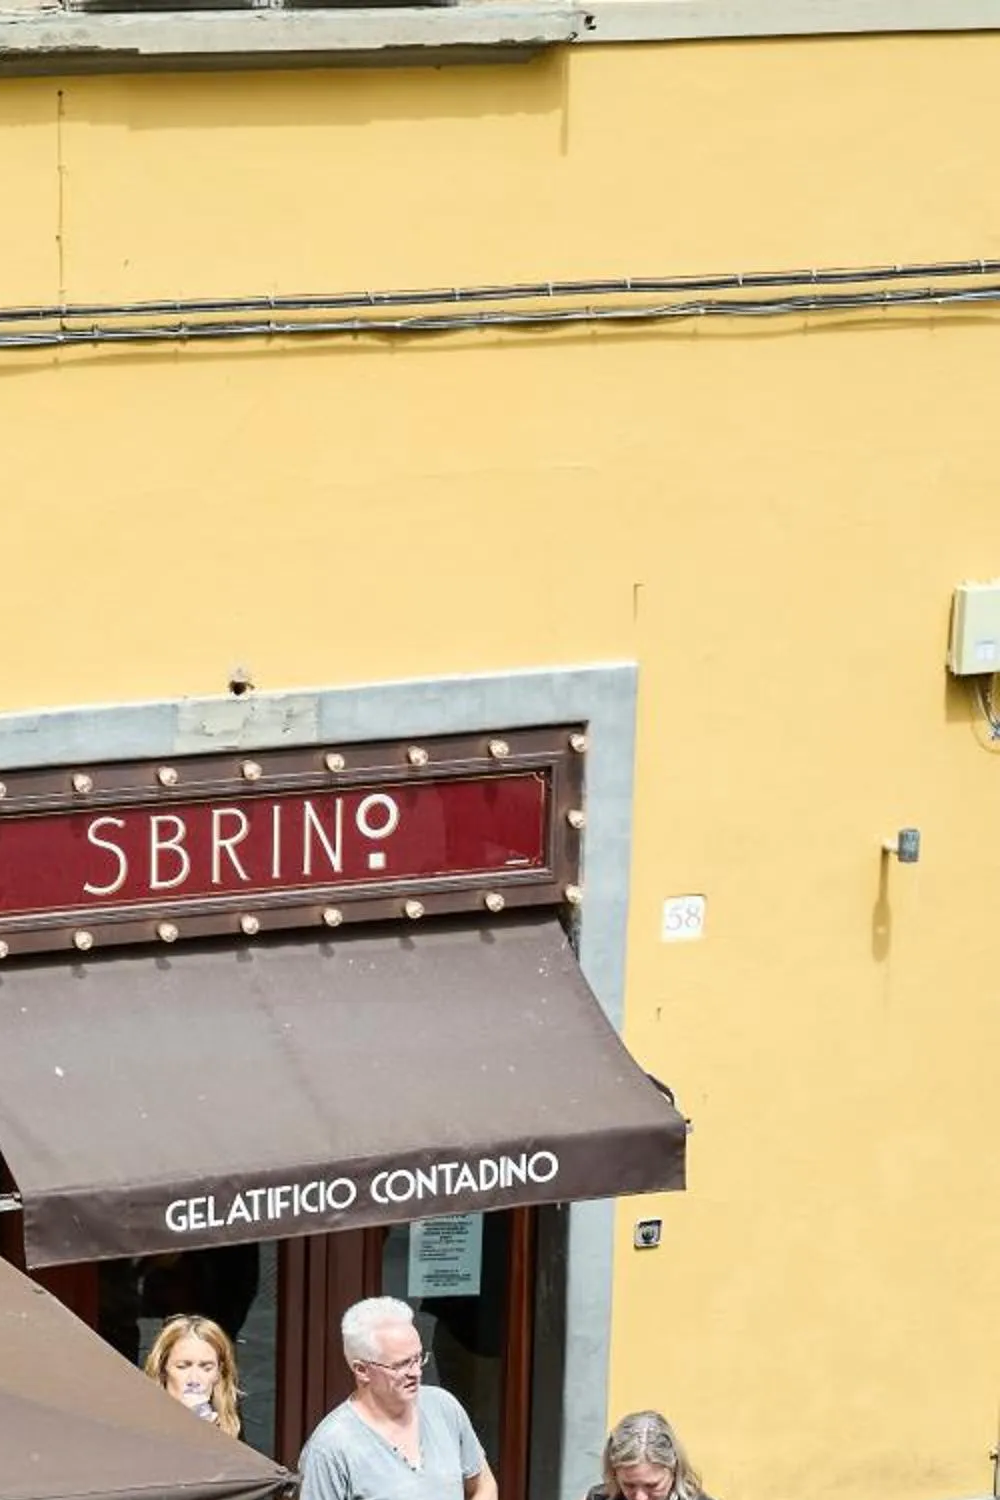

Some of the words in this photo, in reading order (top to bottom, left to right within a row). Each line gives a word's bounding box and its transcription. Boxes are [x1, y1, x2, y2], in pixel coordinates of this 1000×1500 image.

[665, 901, 701, 931] 58
[165, 1177, 357, 1233] GELATIFICIO
[369, 1150, 560, 1205] CONTADINO
